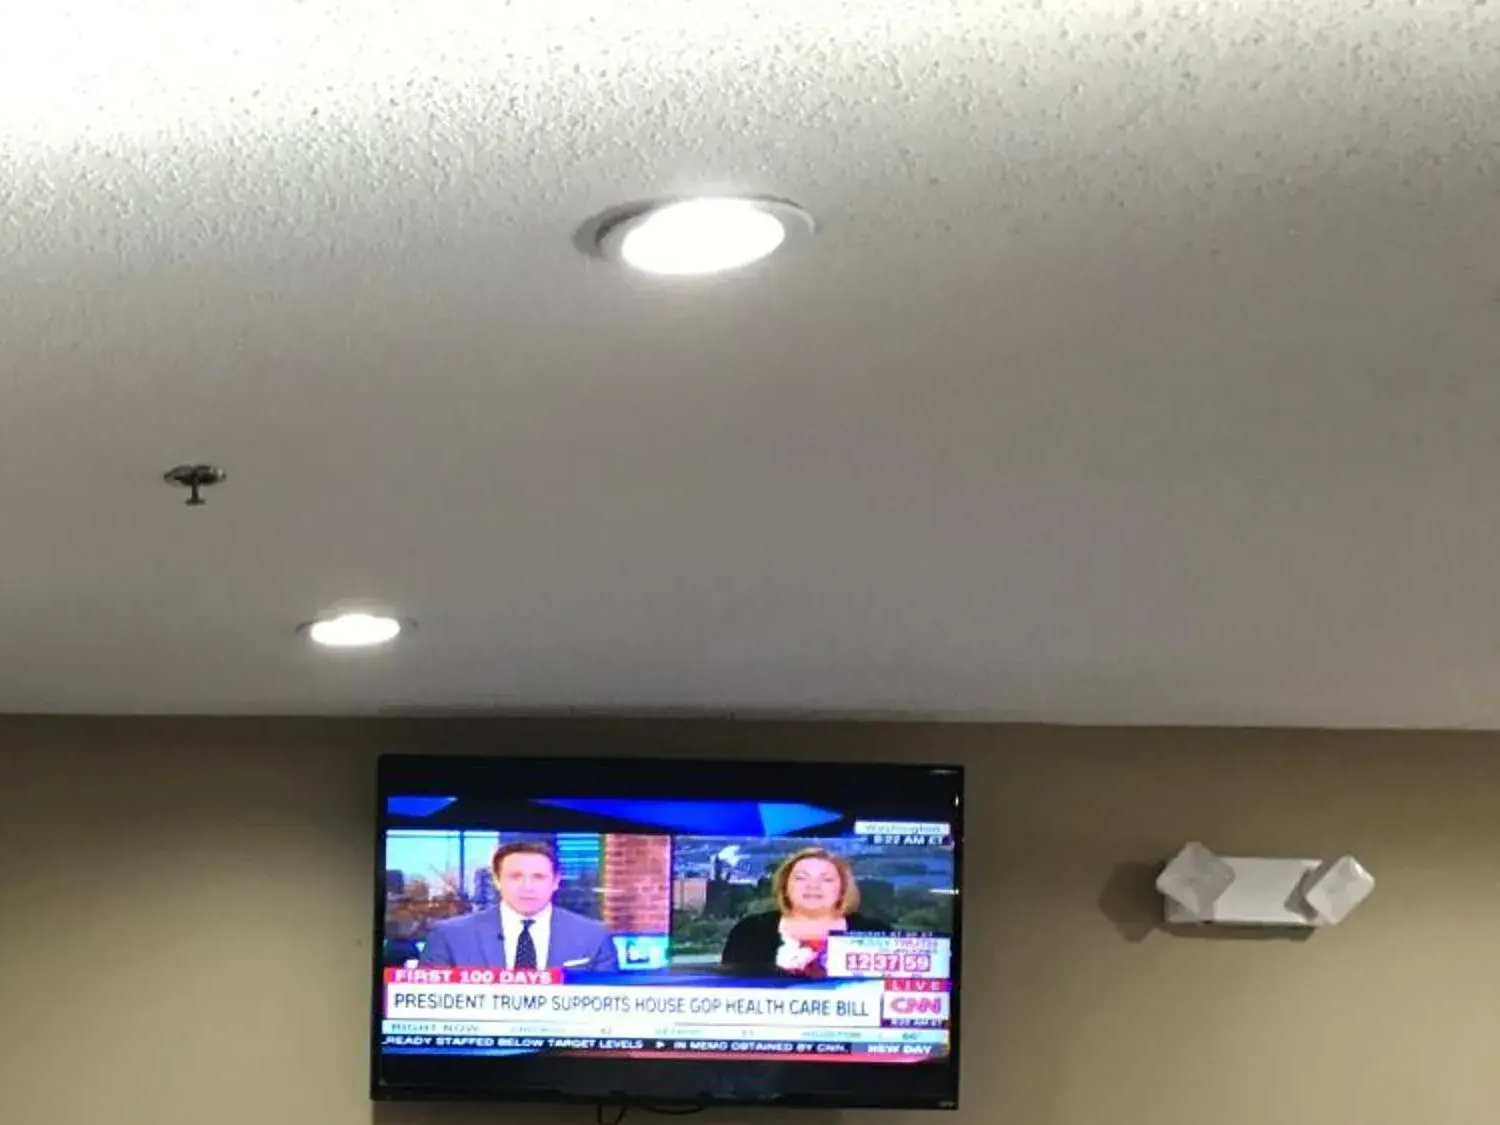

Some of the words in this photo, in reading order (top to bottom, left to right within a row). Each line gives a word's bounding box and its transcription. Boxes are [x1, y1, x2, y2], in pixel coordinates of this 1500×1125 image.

[848, 954, 870, 970] 12
[875, 954, 899, 970] 37
[904, 954, 930, 971] 59
[395, 969, 452, 983] FIRST
[459, 970, 493, 984] 100
[500, 970, 553, 984] DAYS
[891, 979, 941, 991] LIVE
[394, 992, 485, 1010] PRESIDENT
[492, 993, 548, 1011] TRUMP
[552, 994, 631, 1012] SUPPORTS
[635, 996, 686, 1014] HOUSE
[690, 997, 722, 1014] GOP
[726, 998, 785, 1015] HEALTH
[789, 999, 831, 1016] CARE
[836, 1000, 869, 1017] BILL
[890, 997, 942, 1014] CNN
[442, 1024, 480, 1034] NOW
[436, 1037, 494, 1047] STAFFED
[498, 1037, 544, 1048] BELOW
[548, 1038, 597, 1049] TARGET
[599, 1039, 643, 1049] LEVELS
[673, 1040, 687, 1050] IN
[690, 1041, 728, 1051] MEMO
[730, 1042, 793, 1052] OBTAINED
[796, 1043, 814, 1052] BY
[867, 1045, 901, 1054] NEW
[903, 1045, 933, 1055] DAY
